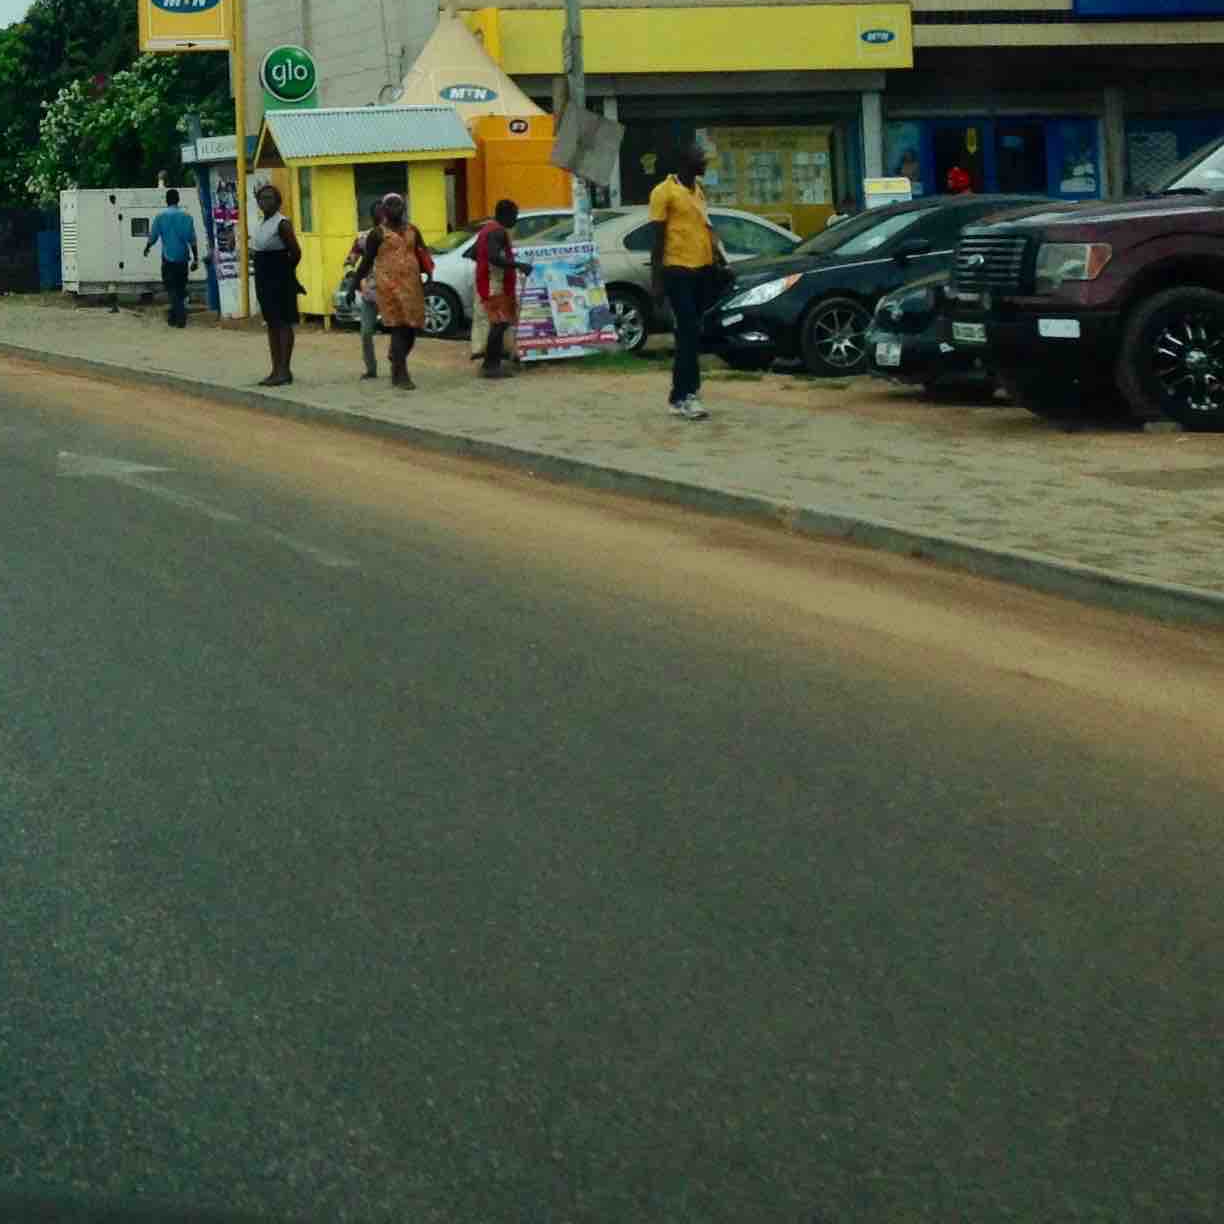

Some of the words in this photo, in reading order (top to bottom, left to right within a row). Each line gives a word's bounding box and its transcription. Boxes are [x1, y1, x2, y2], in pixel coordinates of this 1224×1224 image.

[867, 31, 889, 41] MTN
[271, 58, 308, 88] glo
[449, 87, 488, 99] MTN
